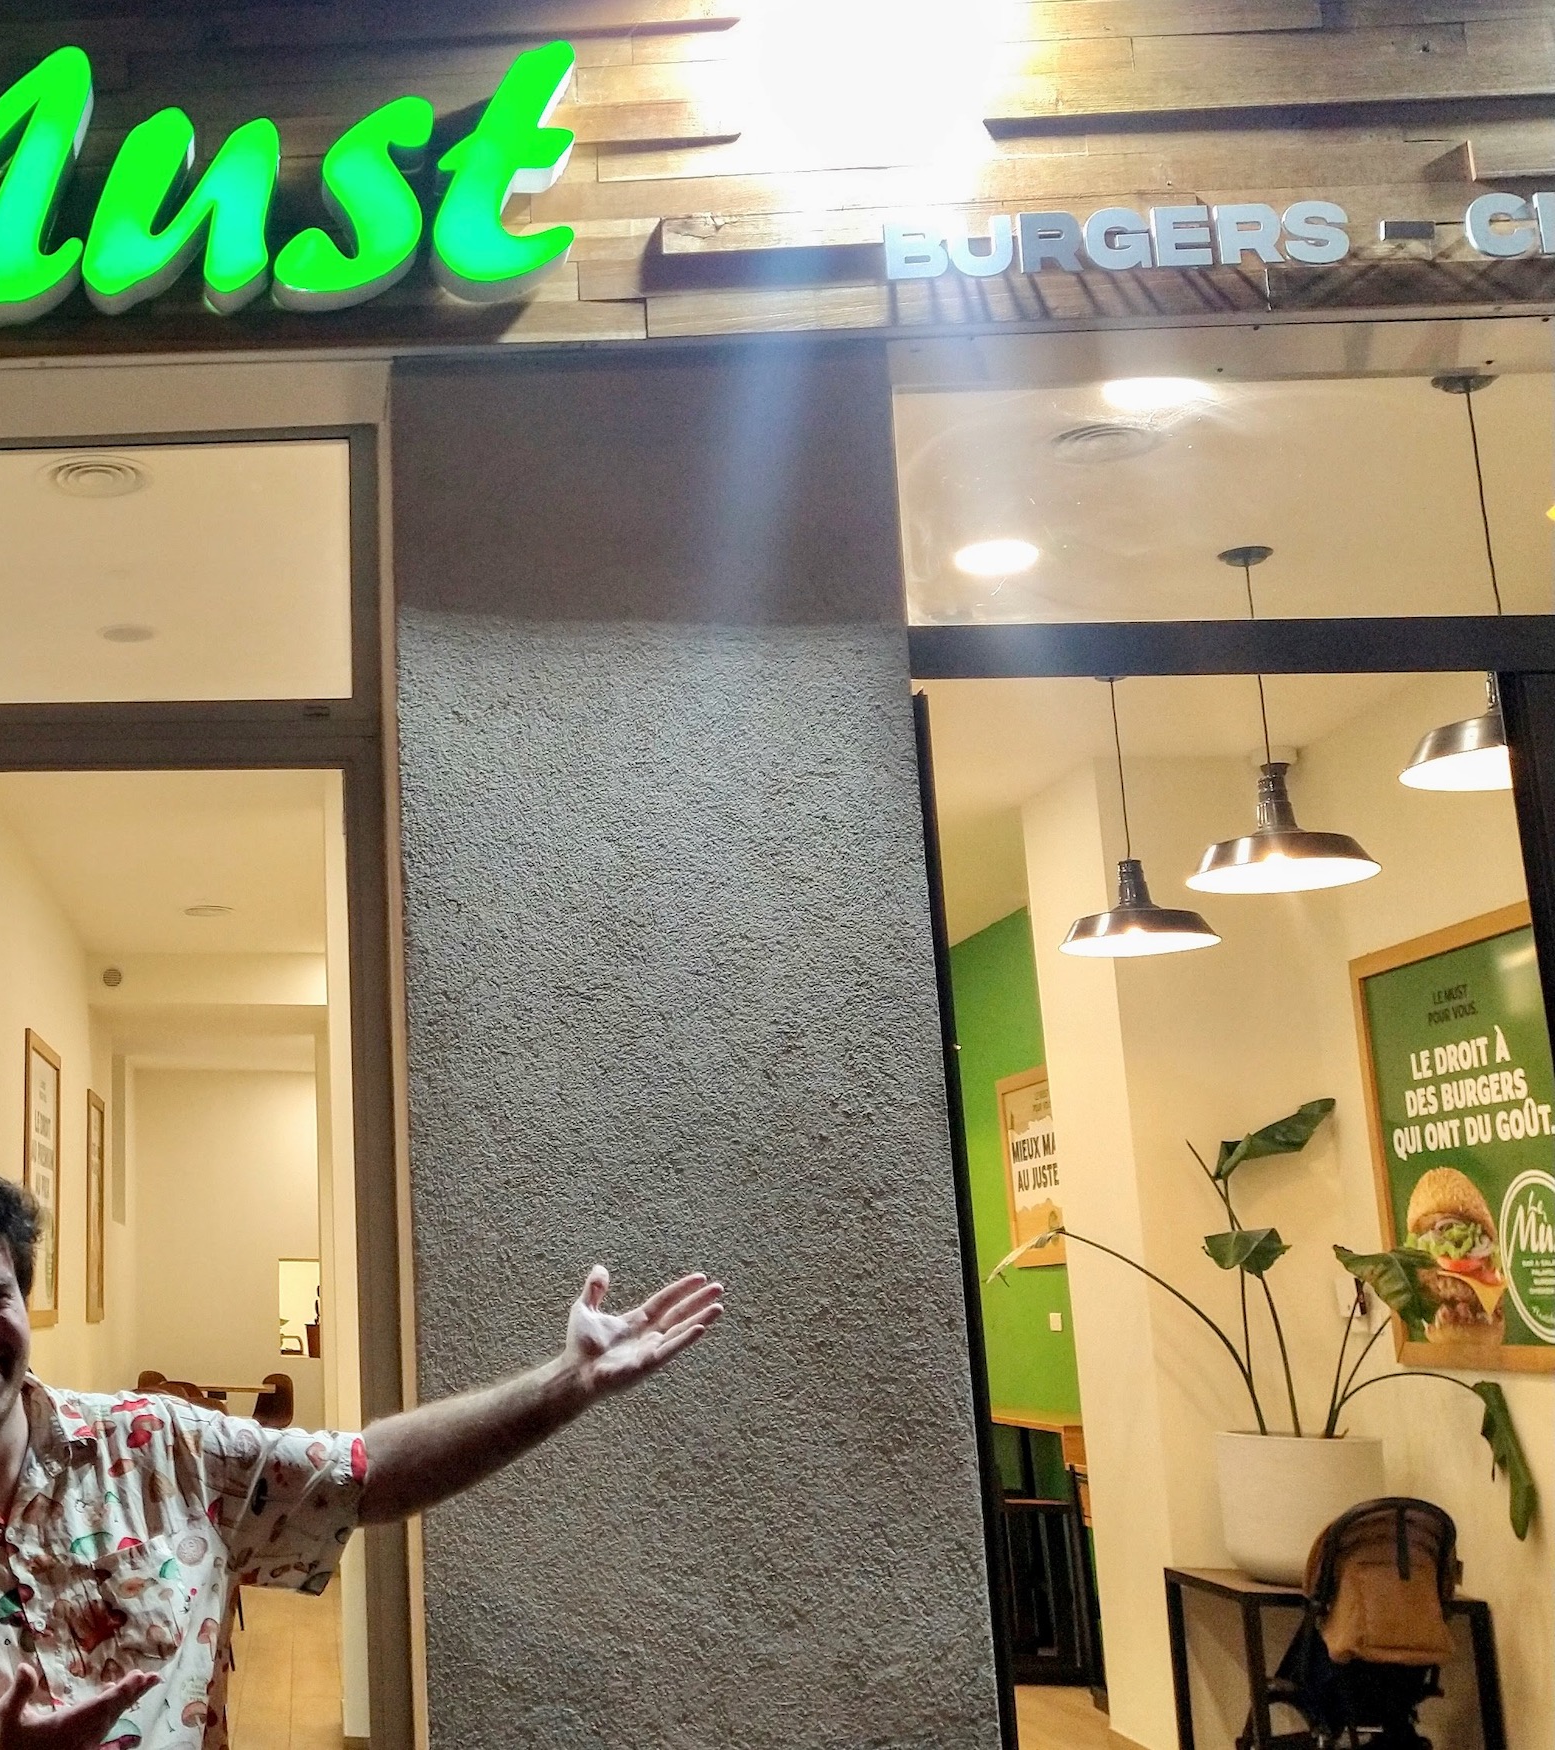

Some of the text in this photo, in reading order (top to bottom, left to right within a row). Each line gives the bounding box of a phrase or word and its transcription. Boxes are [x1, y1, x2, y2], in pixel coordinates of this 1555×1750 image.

[883, 201, 1351, 281] BURGERS
[1410, 1024, 1511, 1081] LE DROIT À
[1404, 1068, 1528, 1118] DES BURGERS
[1011, 1135, 1041, 1164] MIEUX
[1392, 1125, 1423, 1161] QUI
[1424, 1119, 1461, 1152] ONT
[1464, 1113, 1492, 1147] DU
[1017, 1162, 1060, 1192] AU JUSTE
